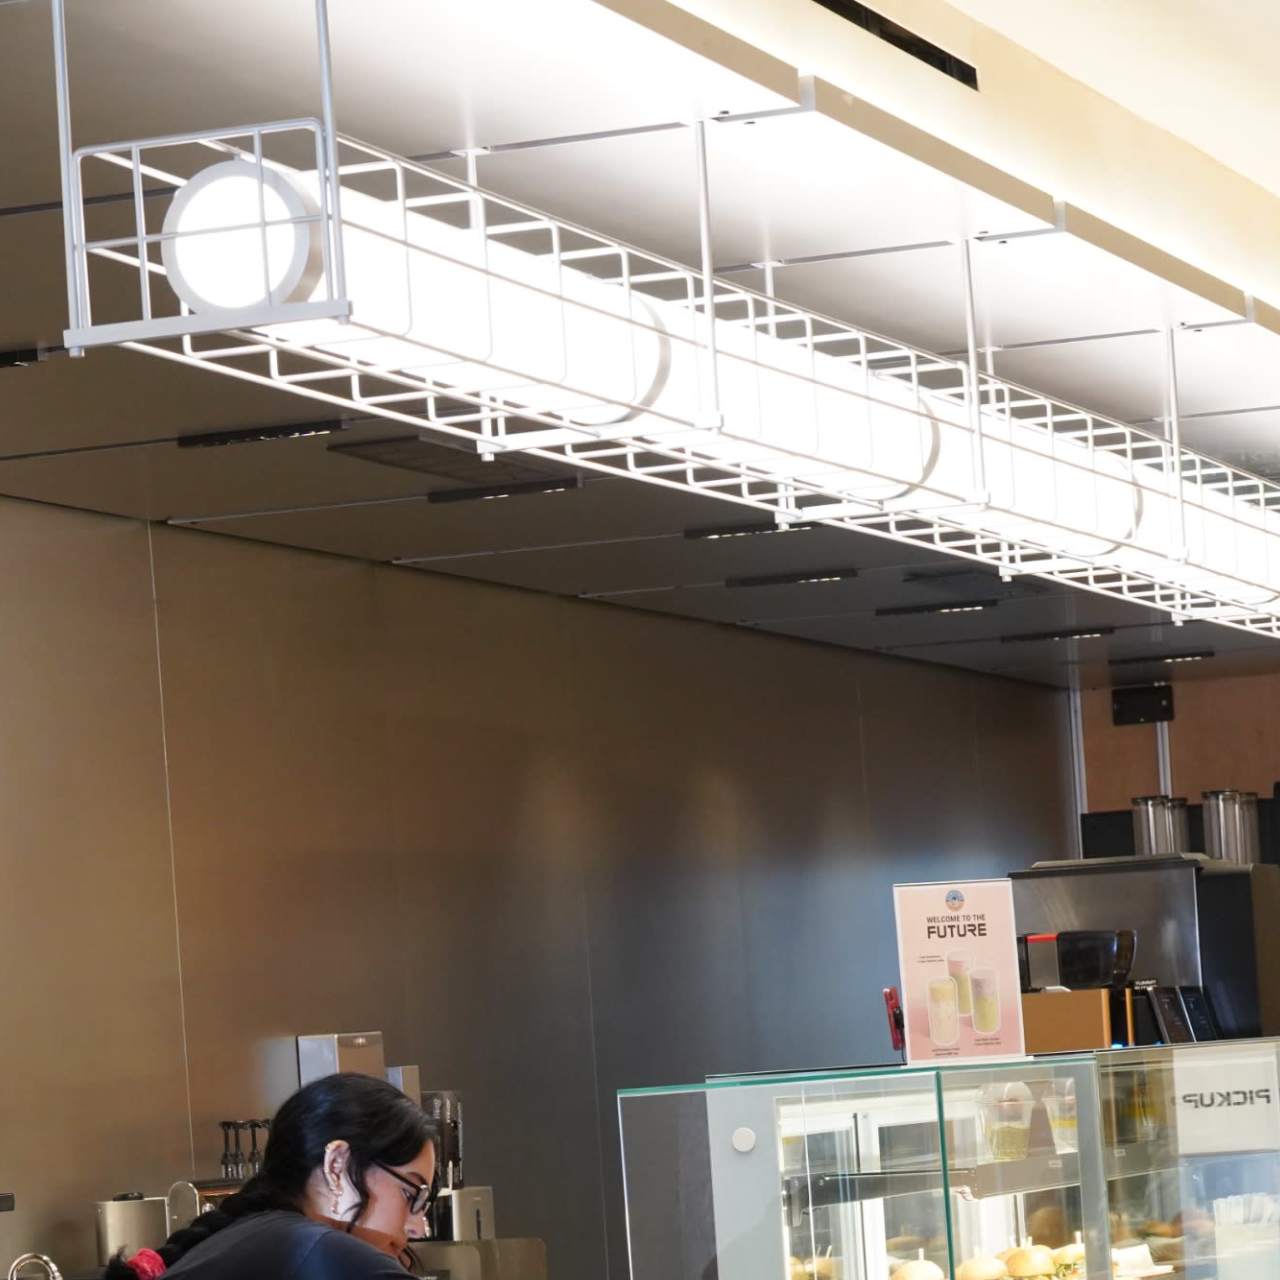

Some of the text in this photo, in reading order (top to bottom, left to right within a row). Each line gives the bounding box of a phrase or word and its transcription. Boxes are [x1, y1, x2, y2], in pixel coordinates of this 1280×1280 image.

[926, 914, 960, 923] WELCOME
[973, 913, 985, 921] THE
[927, 923, 987, 939] FUTURE
